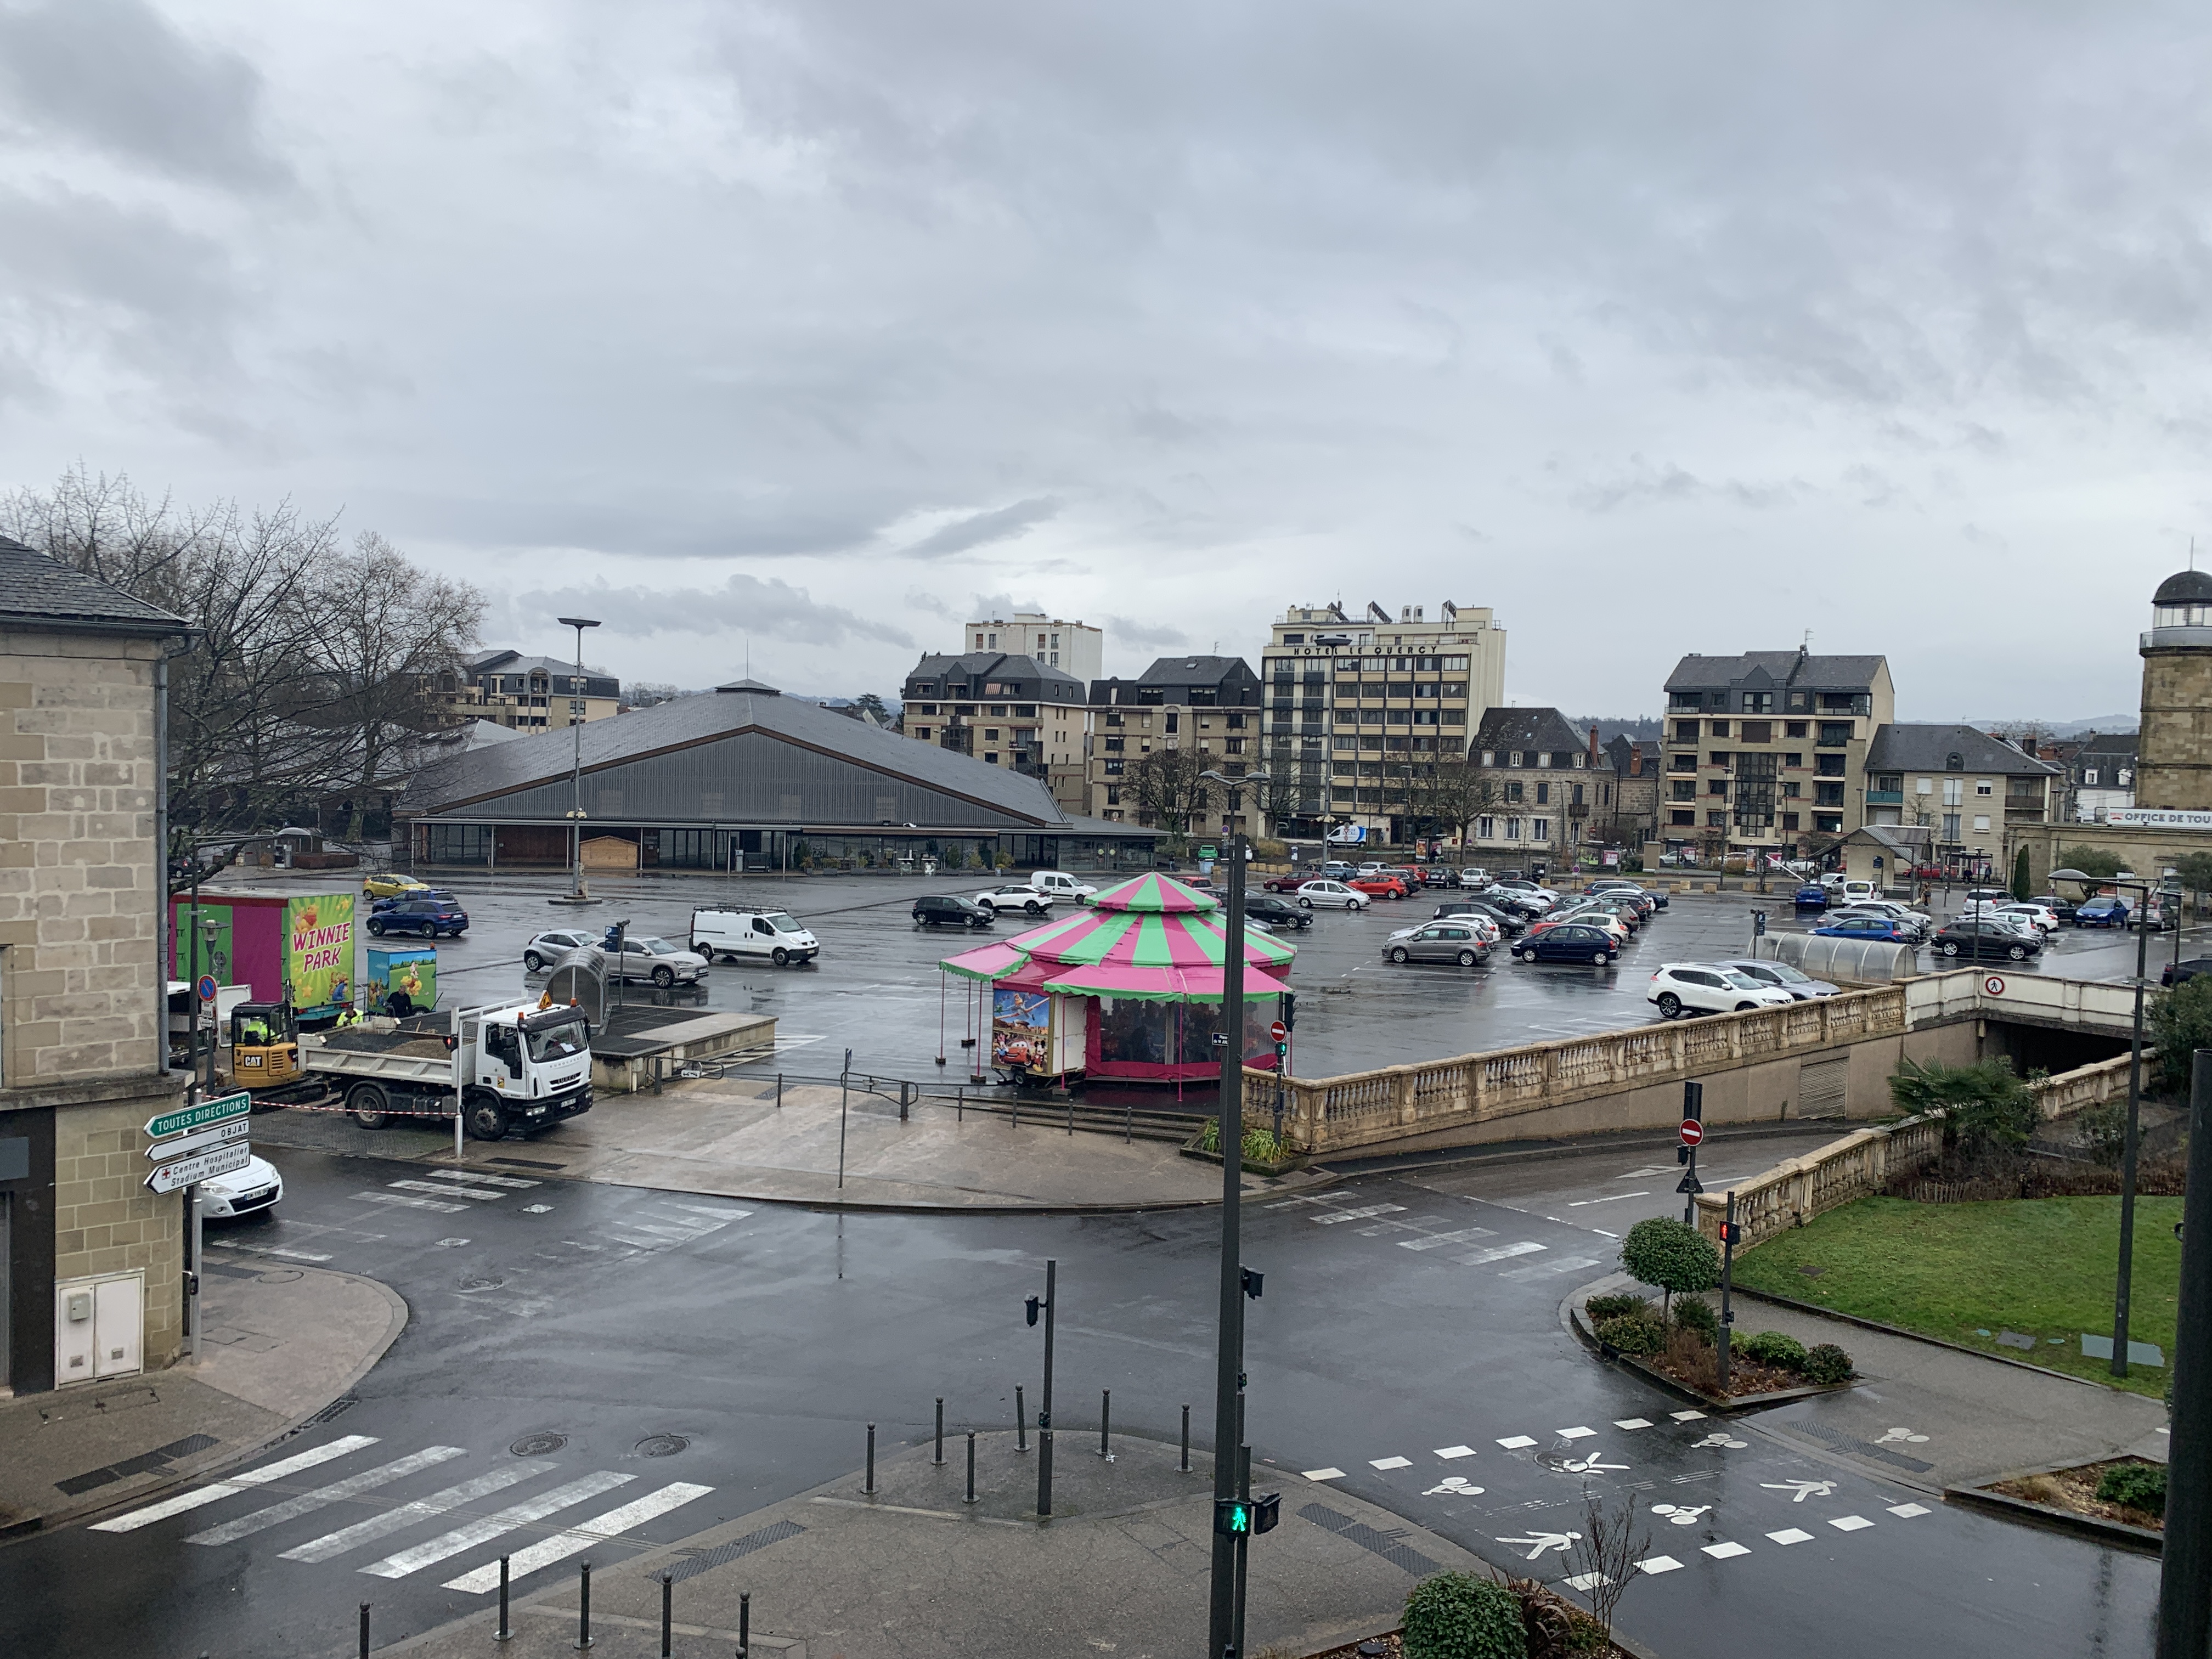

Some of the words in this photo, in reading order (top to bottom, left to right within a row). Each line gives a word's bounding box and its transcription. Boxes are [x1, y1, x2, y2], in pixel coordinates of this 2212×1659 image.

[1374, 646, 1437, 656] QUERCY
[2125, 812, 2165, 822] OFFICE
[2169, 815, 2183, 823] DE
[293, 922, 351, 952] WINNIE
[606, 927, 612, 935] P
[303, 946, 342, 973] PARK
[245, 1056, 262, 1066] CAT
[157, 1114, 192, 1132] TOUTES
[195, 1098, 246, 1122] DIRECTIONS
[221, 1123, 247, 1138] OBJAT
[171, 1171, 205, 1187] Stadium
[208, 1156, 247, 1174] Municipal
[173, 1161, 200, 1175] Centre
[204, 1147, 247, 1166] Hospitalier
